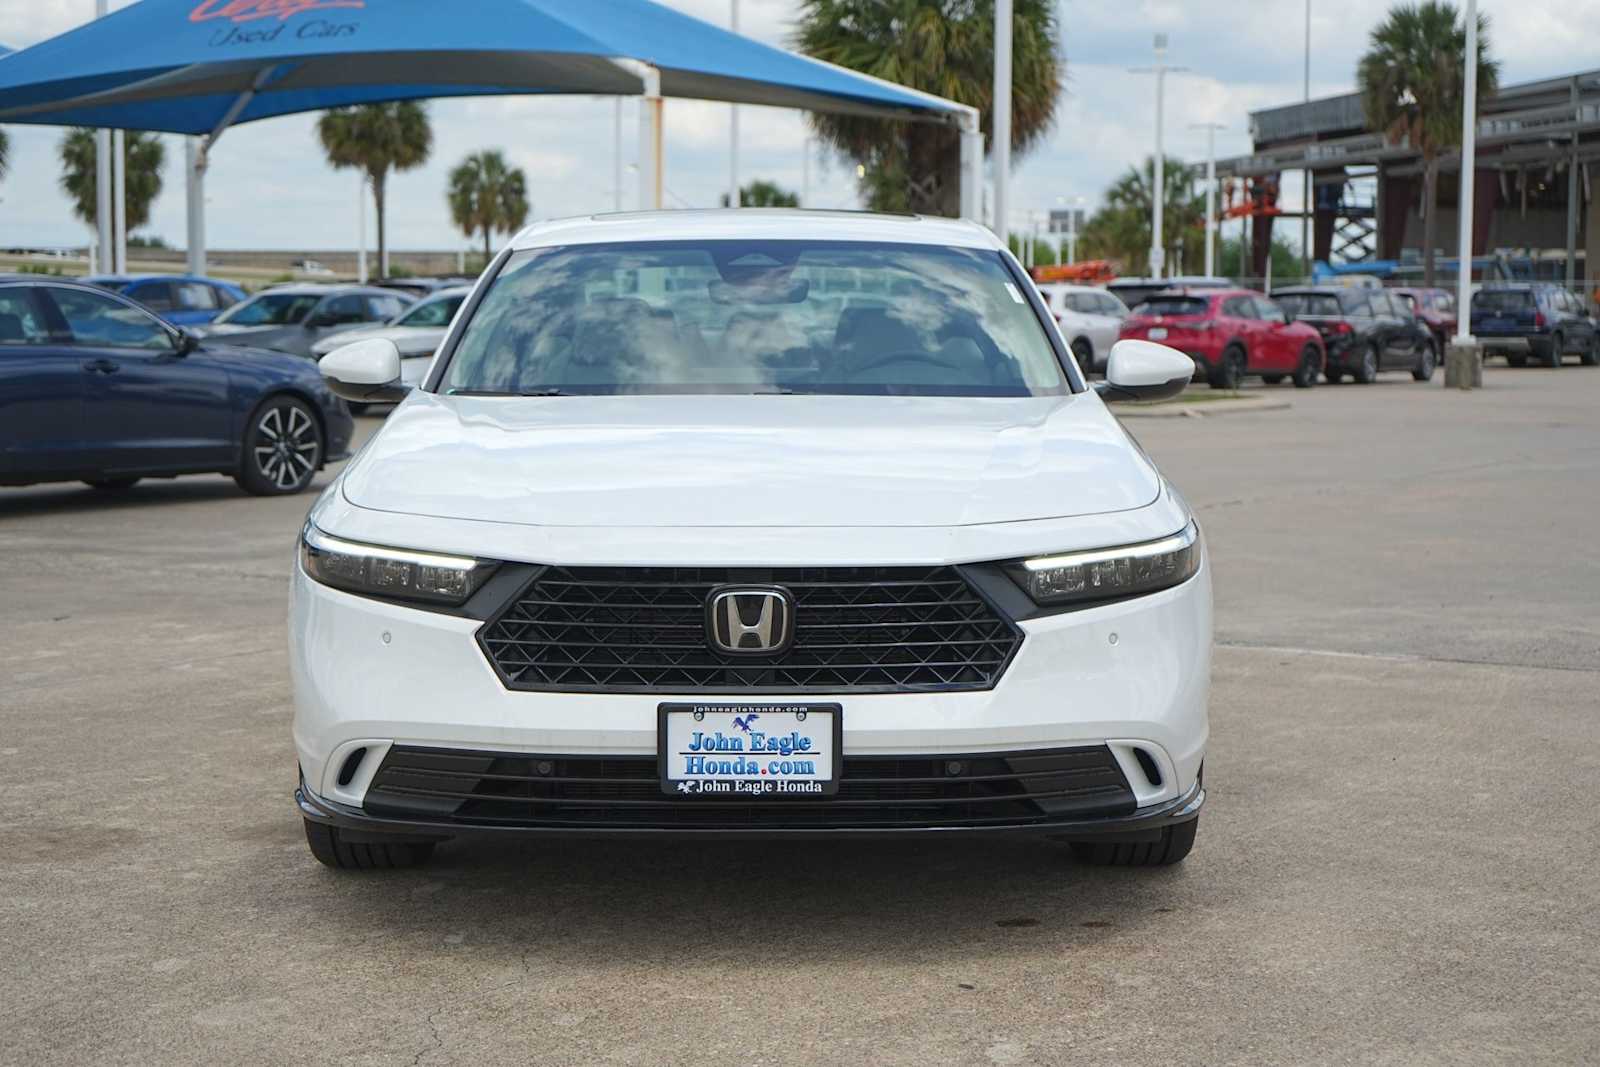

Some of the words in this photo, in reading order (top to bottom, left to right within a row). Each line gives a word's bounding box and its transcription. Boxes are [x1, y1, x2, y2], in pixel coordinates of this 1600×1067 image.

[208, 24, 286, 48] Used
[296, 19, 360, 39] Cars
[688, 731, 744, 752] John
[749, 731, 812, 756] Eagle
[684, 755, 815, 775] Honda.com
[696, 780, 730, 793] John
[735, 780, 773, 795] Eagle
[777, 780, 822, 793] Honda
